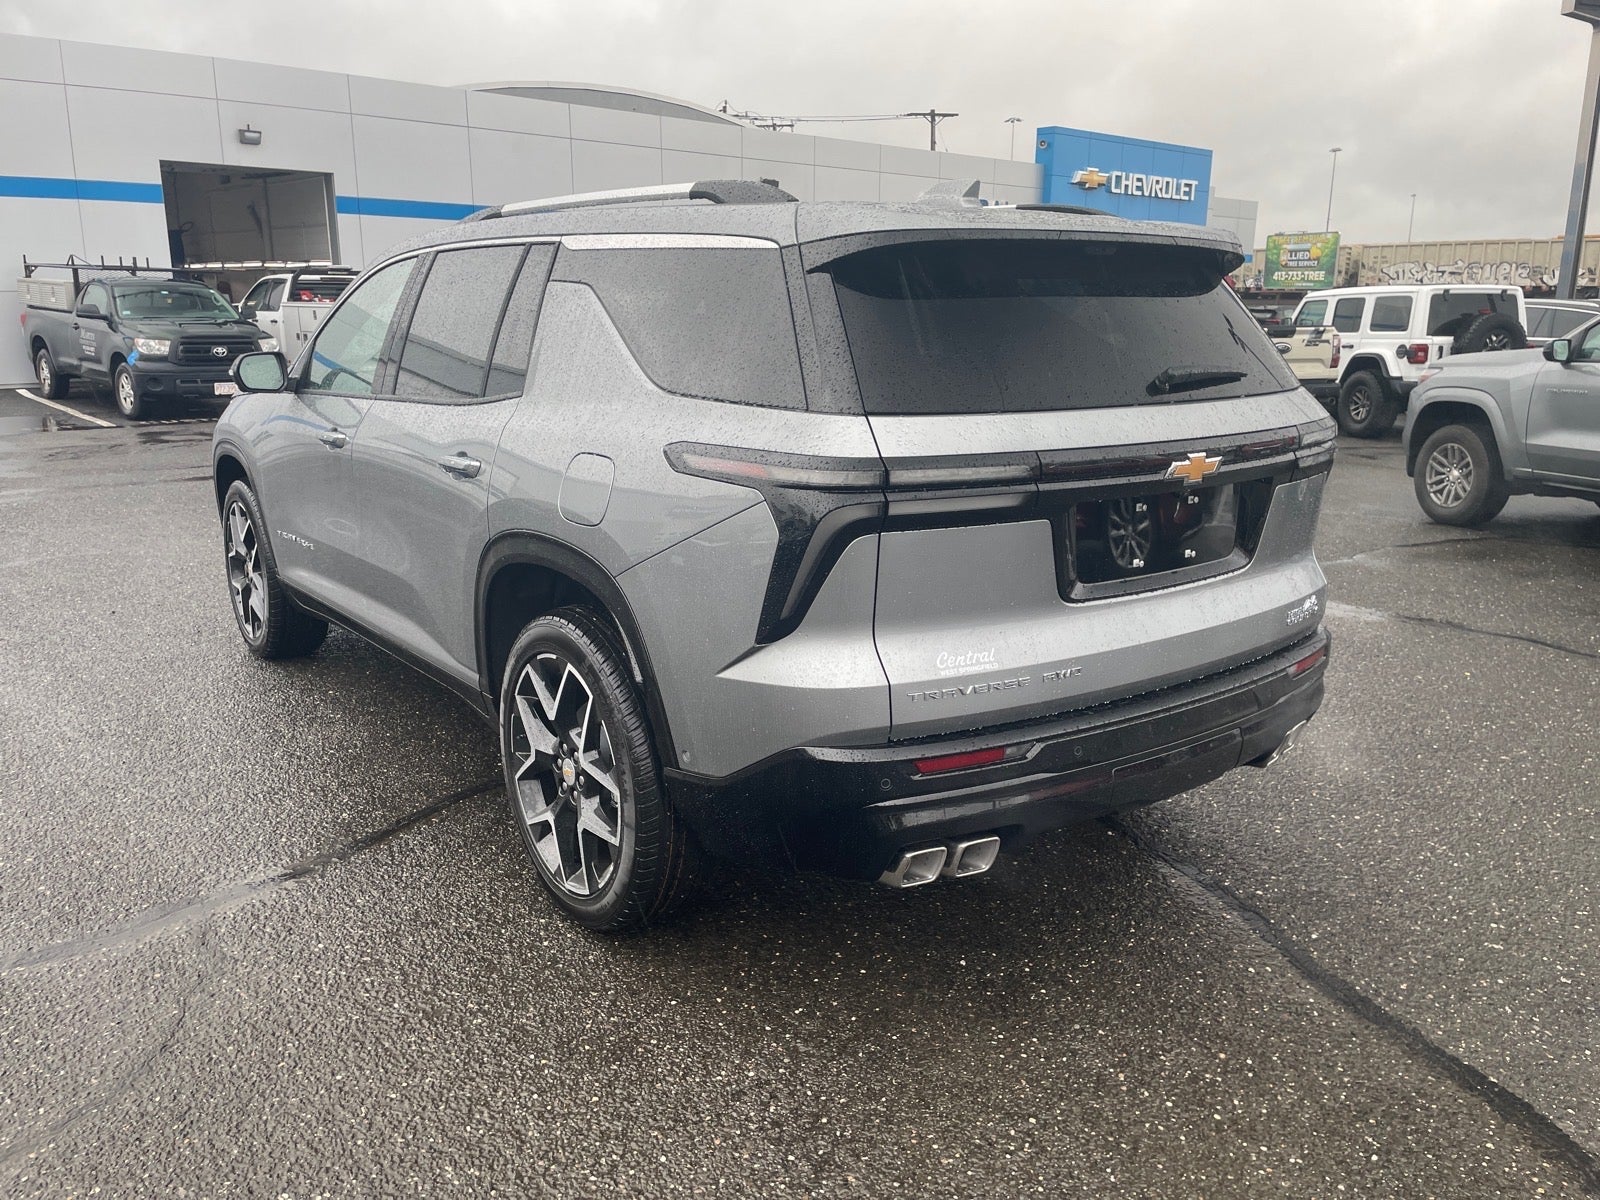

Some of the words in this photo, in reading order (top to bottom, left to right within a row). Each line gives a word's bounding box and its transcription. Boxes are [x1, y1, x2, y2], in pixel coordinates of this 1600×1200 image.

[1110, 170, 1199, 201] CHEVROLET
[936, 647, 996, 669] Central
[906, 676, 1032, 702] TRAVERSE
[1042, 666, 1083, 683] AWD
